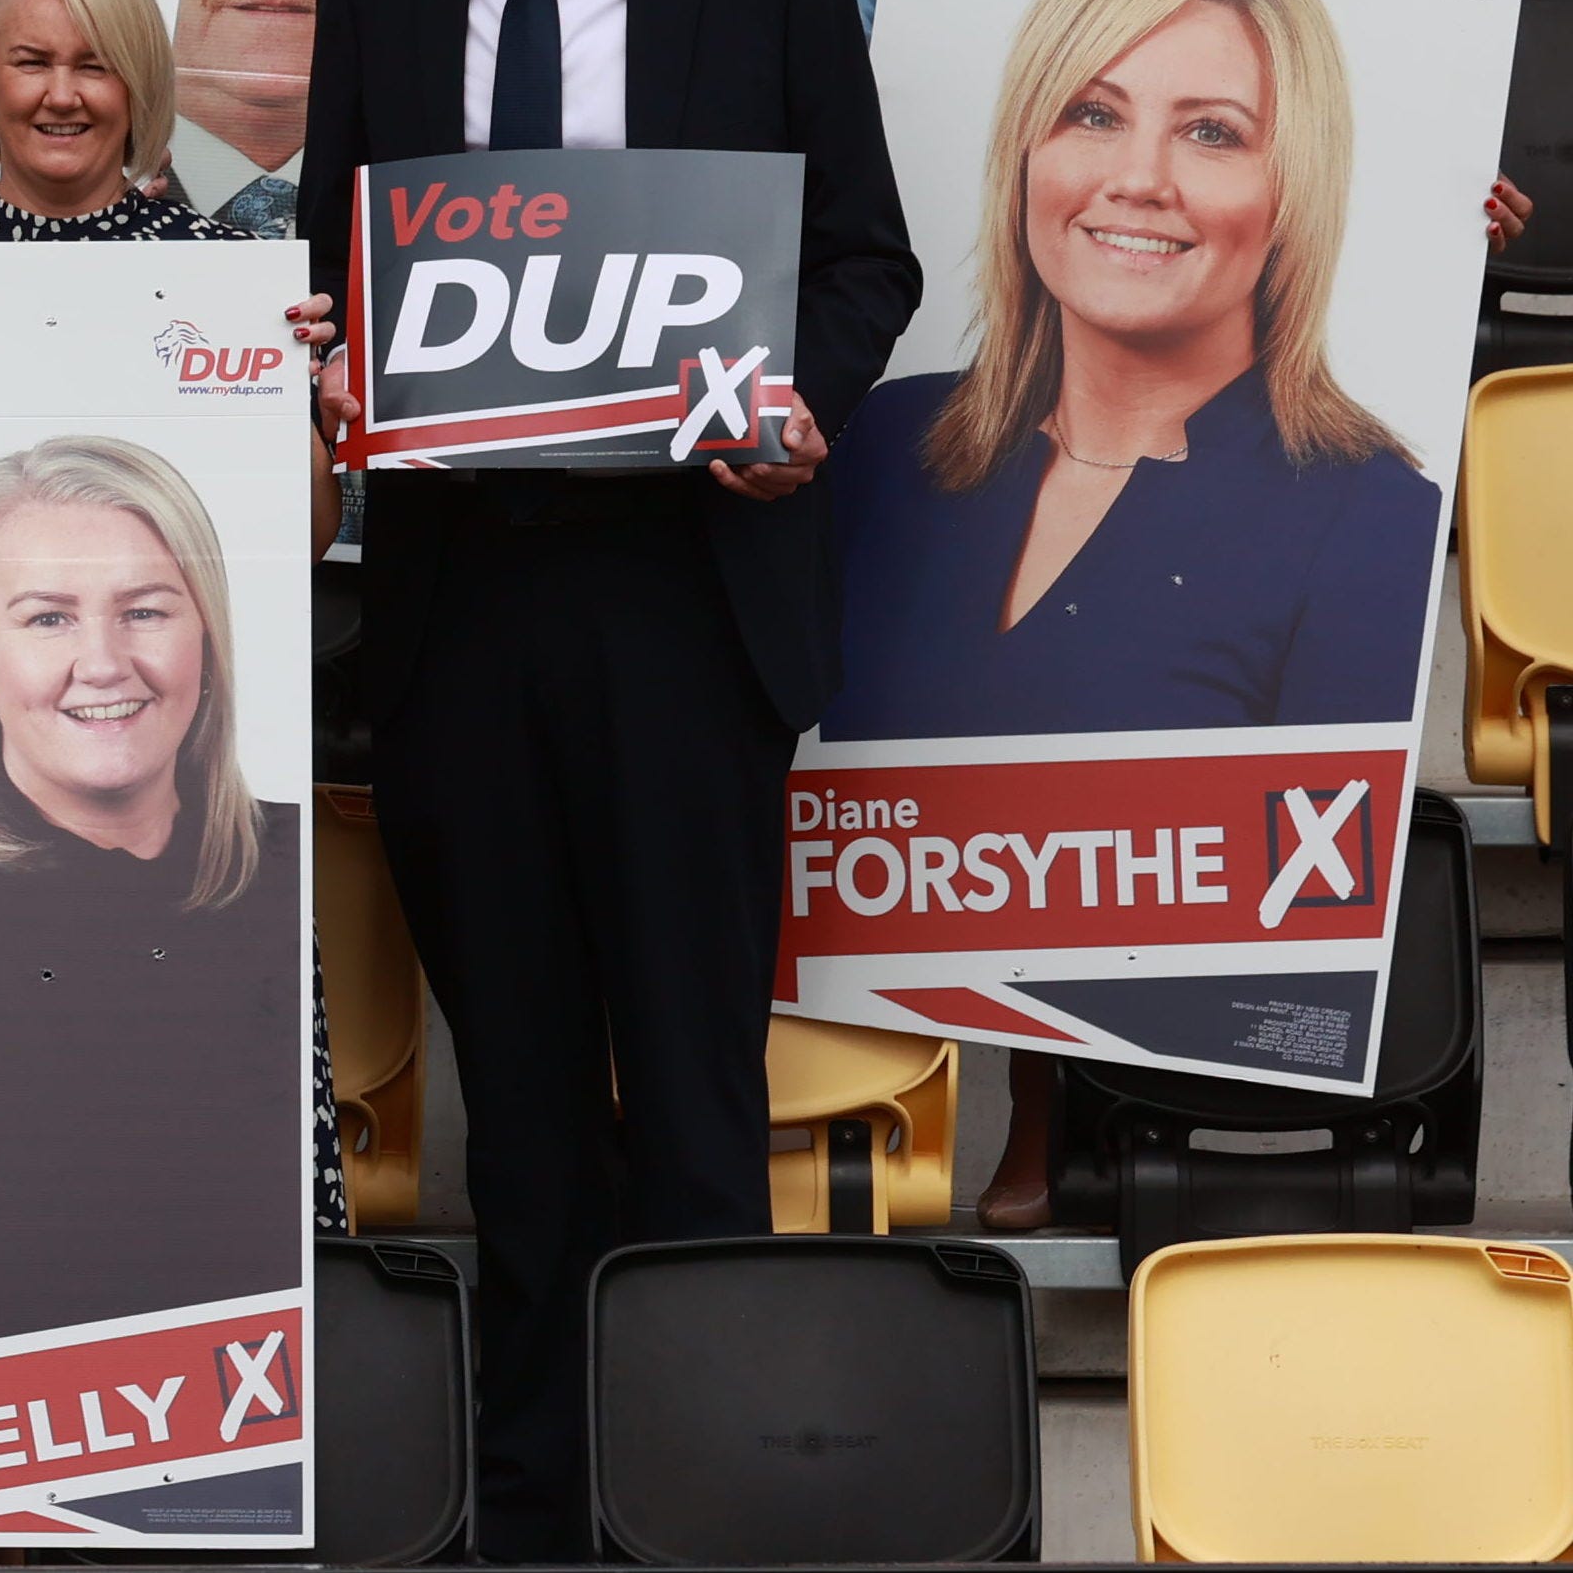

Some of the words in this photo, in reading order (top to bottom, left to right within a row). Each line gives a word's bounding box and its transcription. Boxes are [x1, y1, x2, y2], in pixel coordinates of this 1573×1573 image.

[389, 182, 569, 247] Vote
[384, 253, 743, 374] DUP
[178, 384, 284, 397] www.mydup.com
[179, 347, 283, 382] DUP
[791, 789, 919, 832] Diane
[790, 826, 1228, 917] FORSYTHE
